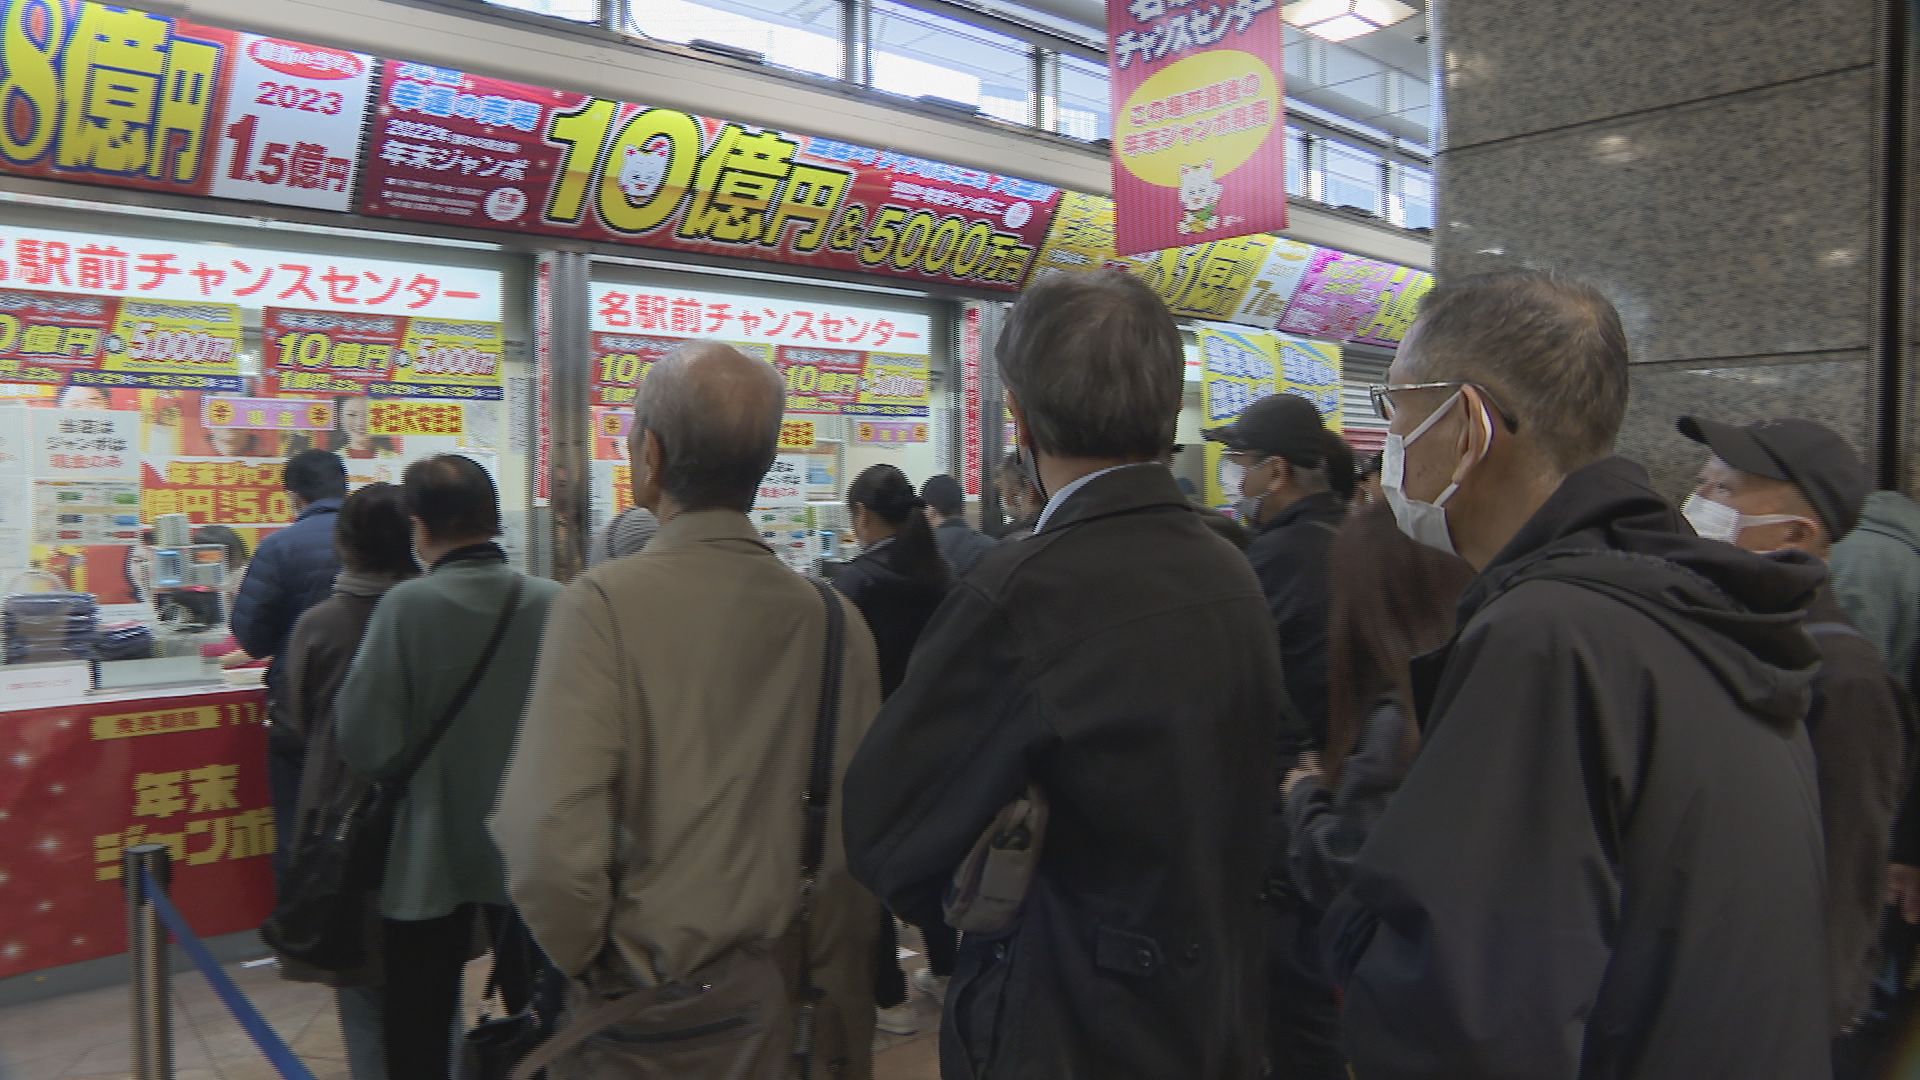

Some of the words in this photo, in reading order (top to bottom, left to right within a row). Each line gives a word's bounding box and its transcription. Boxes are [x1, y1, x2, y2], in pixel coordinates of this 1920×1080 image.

[1116, 0, 1274, 69] チャンスセンター
[256, 81, 343, 115] 2023
[389, 79, 543, 132] 幸運の売場
[1131, 73, 1261, 126] この場所最後の
[387, 119, 451, 142] 2022年
[1124, 98, 1270, 156] 年末ジャンボ発売
[227, 113, 351, 193] 1.5億円
[380, 139, 531, 181] 年末ジャンボ
[543, 94, 854, 252] 10億円
[829, 204, 866, 252] &
[857, 204, 1034, 283] 5000万円
[0, 239, 480, 309] 駅前チャンスセンター
[1266, 262, 1299, 280] 2017
[279, 312, 396, 334] 年末ジャンボ
[599, 290, 920, 347] 名駅前チャンスセンター
[275, 331, 395, 371] 10億円
[599, 352, 654, 386] 10
[783, 363, 859, 394] 10億円
[60, 417, 114, 434] 当店は
[370, 402, 461, 433] 本日大安吉日
[47, 436, 127, 453] ジャンボは
[50, 453, 123, 469] 現金のみ
[167, 460, 288, 487] 年末ジャン
[759, 486, 799, 499] 現金のみ
[115, 710, 200, 733] 発売期間
[133, 764, 240, 820] 年末
